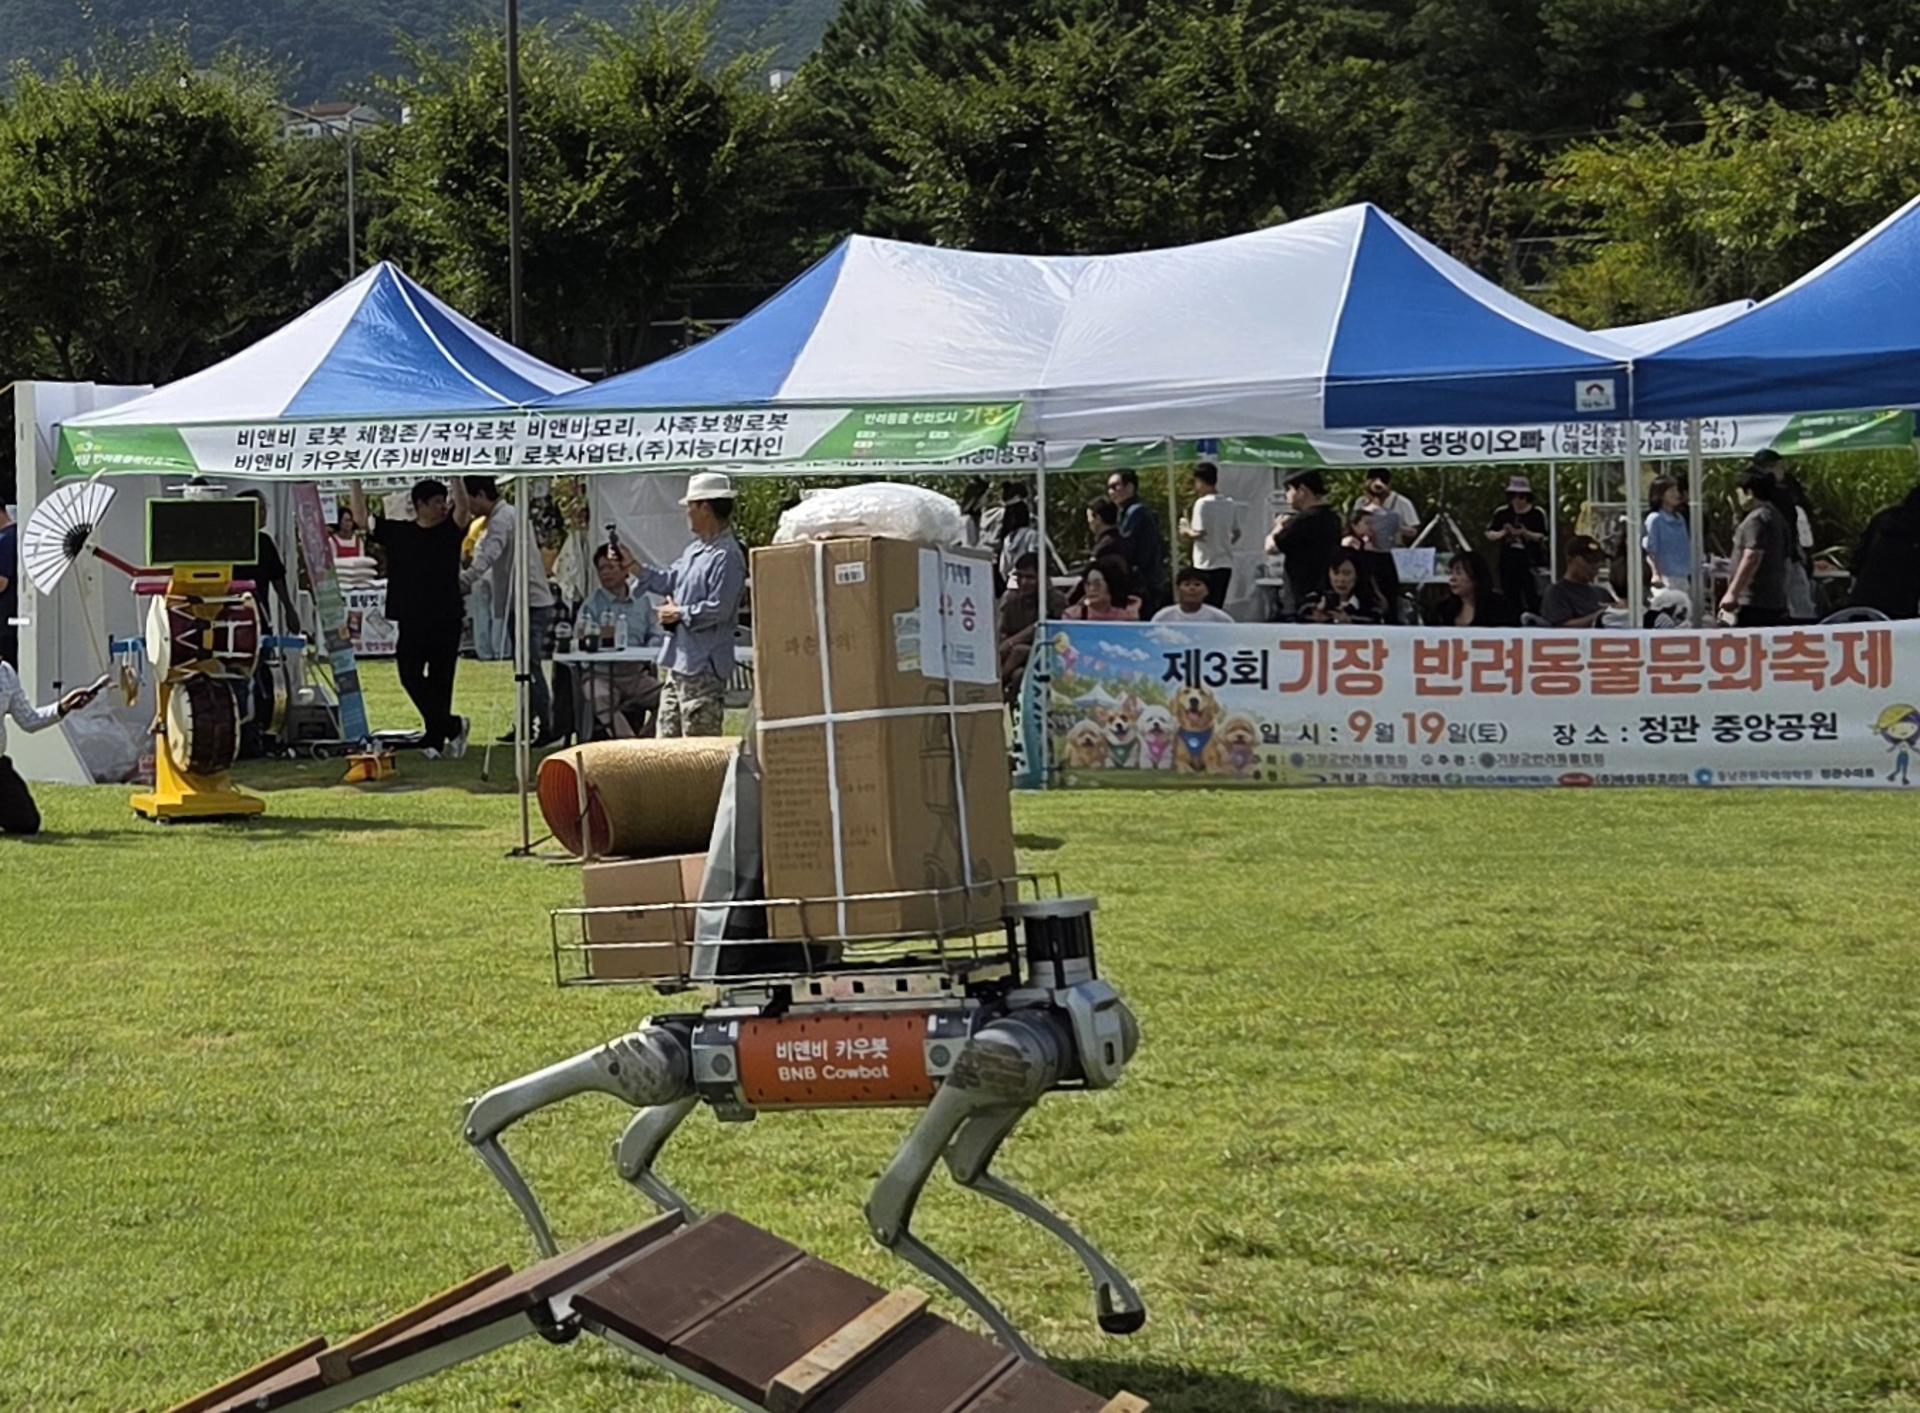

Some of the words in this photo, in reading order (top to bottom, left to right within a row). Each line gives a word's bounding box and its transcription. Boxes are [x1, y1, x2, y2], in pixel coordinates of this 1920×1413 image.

[237, 427, 297, 449] 비앤비
[305, 426, 348, 446] 로봇
[356, 420, 517, 444] 체험존/국악로봇
[654, 412, 789, 435] 사족보행로봇
[1360, 430, 1410, 458] 정관
[1420, 429, 1545, 457] 댕댕이오빠
[234, 451, 294, 472] 비앤비
[1161, 648, 1269, 690] 제3회
[1278, 638, 1389, 696] 기장
[1412, 629, 1893, 696] 반려동물문화축제
[1347, 709, 1395, 743] 9월
[1401, 711, 1508, 745] 19일(토)
[1552, 723, 1577, 746] 장
[1584, 724, 1610, 744] 소
[1638, 714, 1700, 744] 정관
[1711, 711, 1839, 743] 중앙공원
[775, 1038, 828, 1061] 비앤비
[835, 1037, 890, 1060] 카우봇
[777, 1065, 818, 1082] BNB
[821, 1064, 890, 1080] Cowbot
